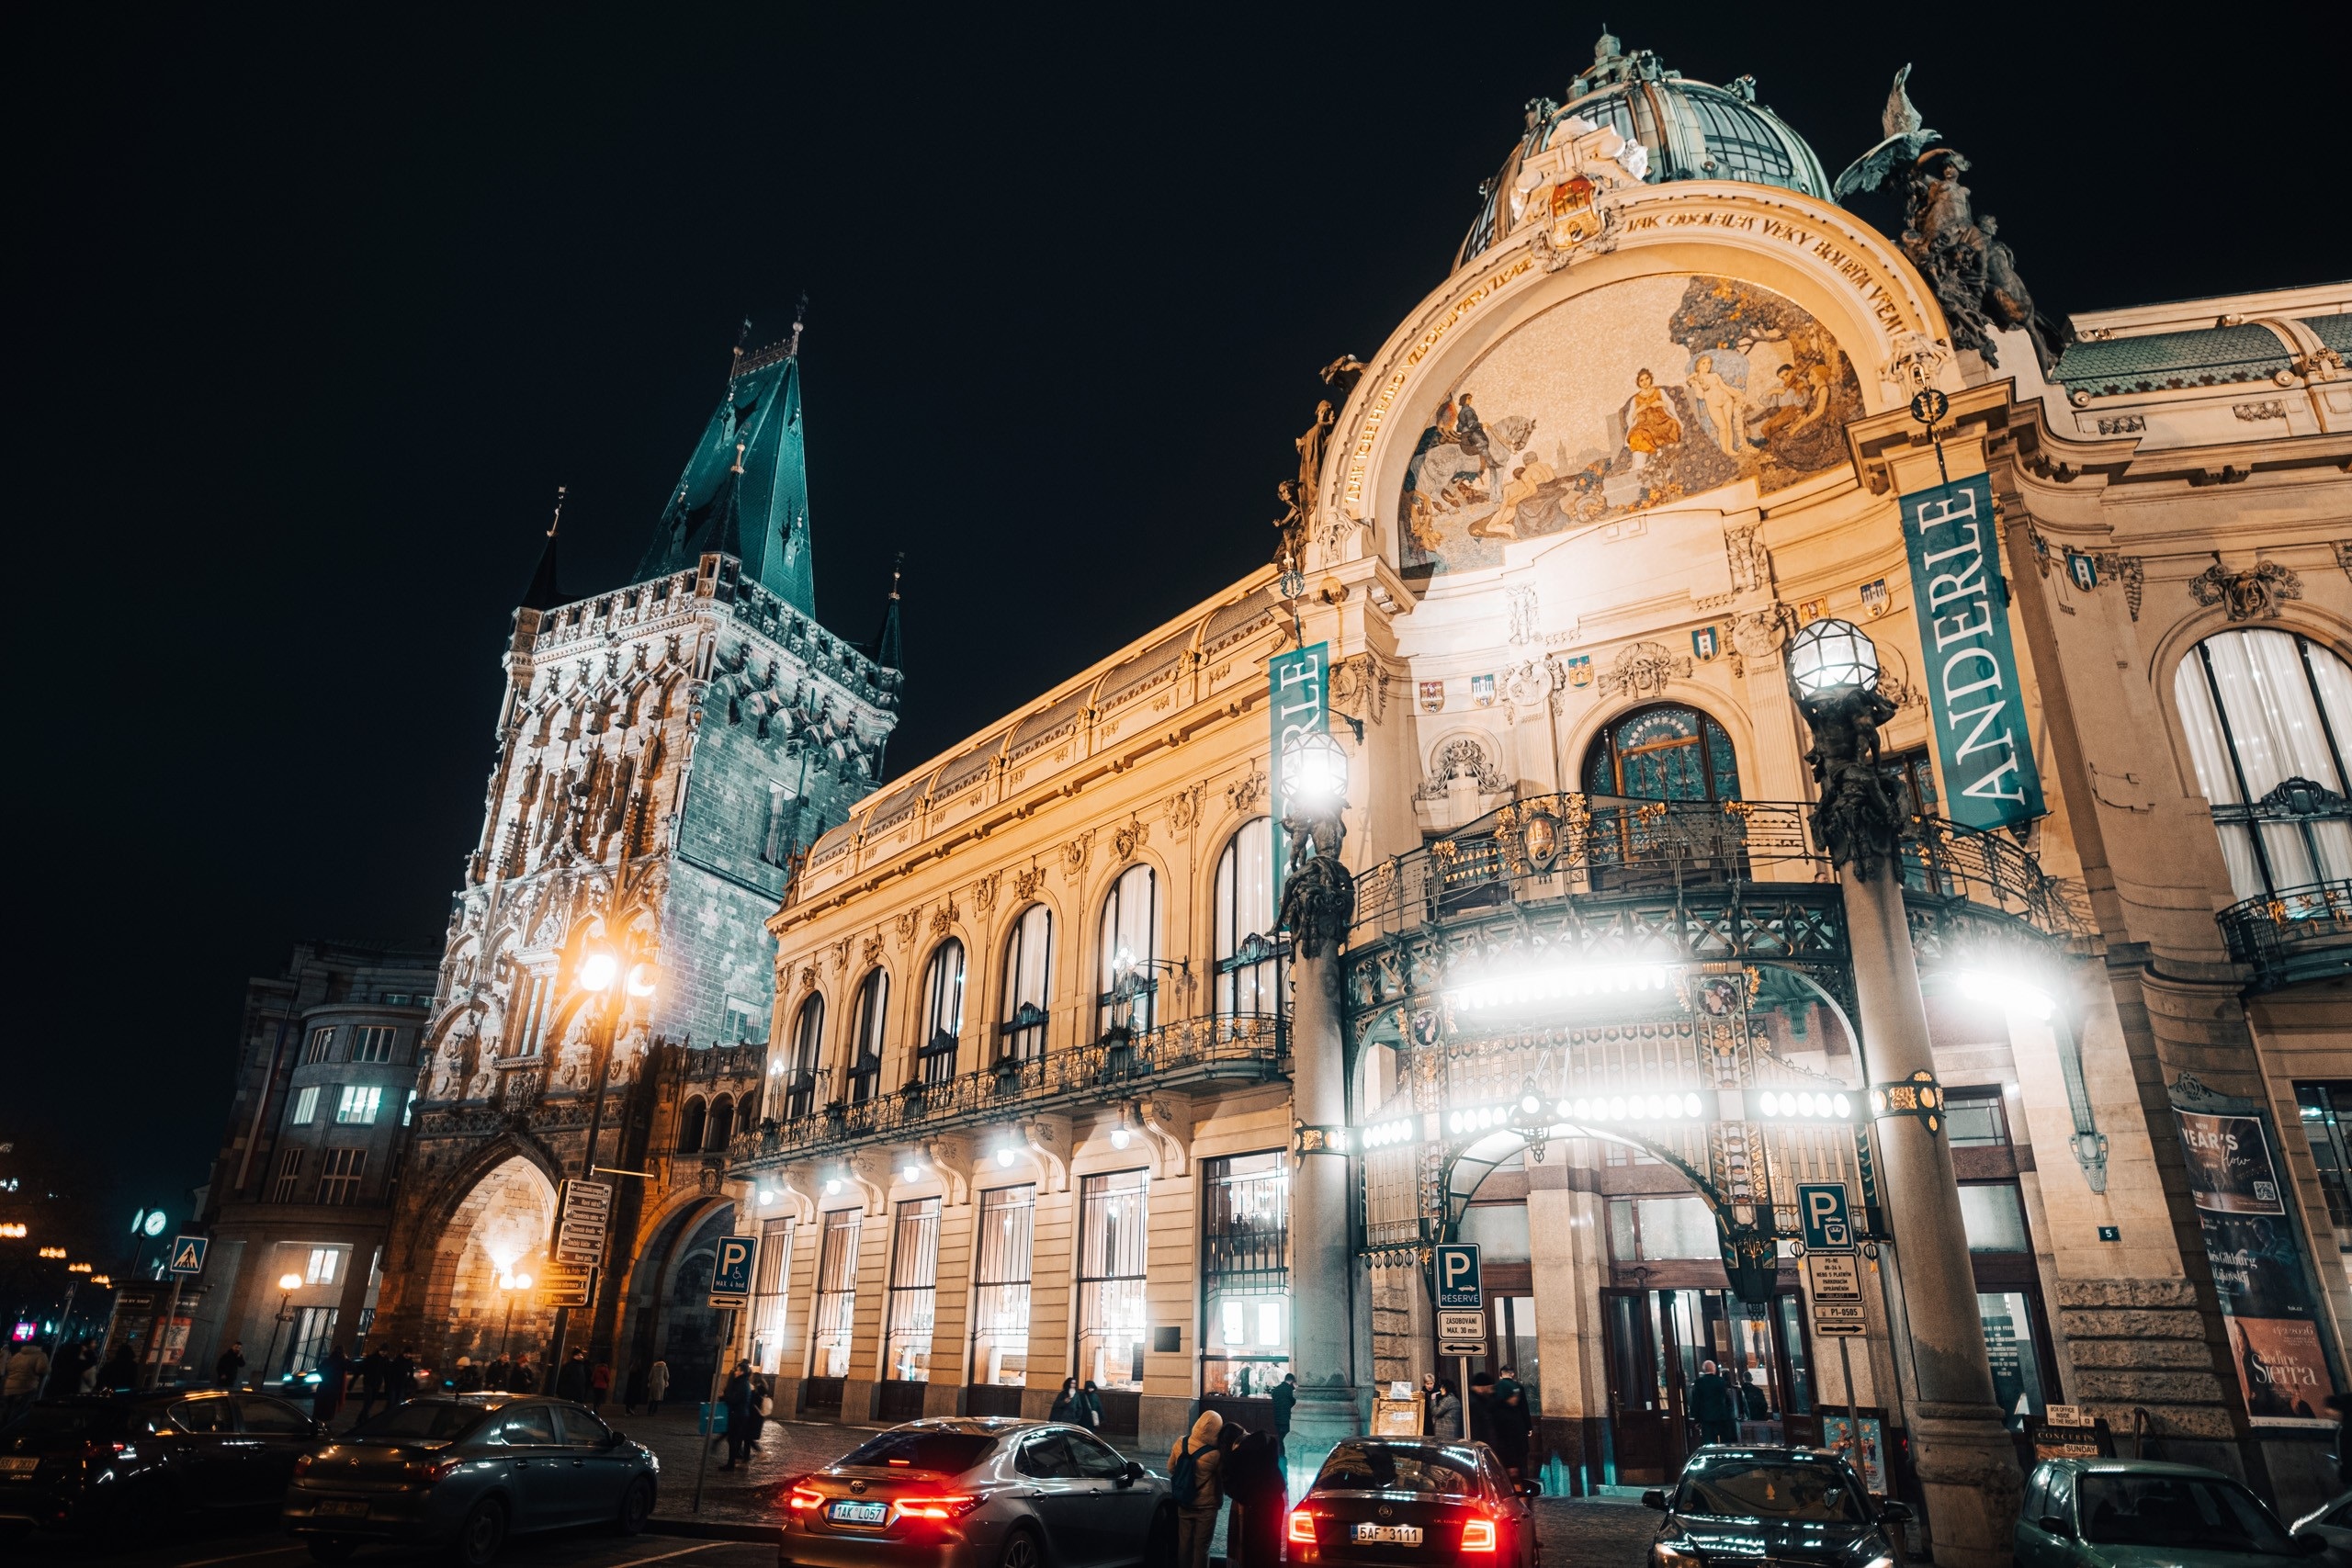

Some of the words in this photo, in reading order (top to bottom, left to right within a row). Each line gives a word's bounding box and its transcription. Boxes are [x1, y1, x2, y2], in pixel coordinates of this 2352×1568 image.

[1917, 487, 2026, 806] ANDERLE
[2181, 1127, 2239, 1151] YEAR'S
[1808, 1191, 1838, 1230] P
[2104, 1229, 2113, 1238] 5
[721, 1243, 747, 1276] P
[1444, 1252, 1471, 1289] P
[1441, 1293, 1479, 1303] RÉSERVÉ
[1830, 1308, 1858, 1317] P1-0505
[1445, 1316, 1477, 1325] ZÁSOBOVÁNÍ
[2251, 1353, 2320, 1387] Sierra
[2038, 1432, 2095, 1442] CONCERTS
[2065, 1444, 2096, 1453] SUNDAY
[837, 1506, 854, 1519] 1AK
[1360, 1527, 1380, 1540] 5AF
[1389, 1528, 1418, 1541] 3111
